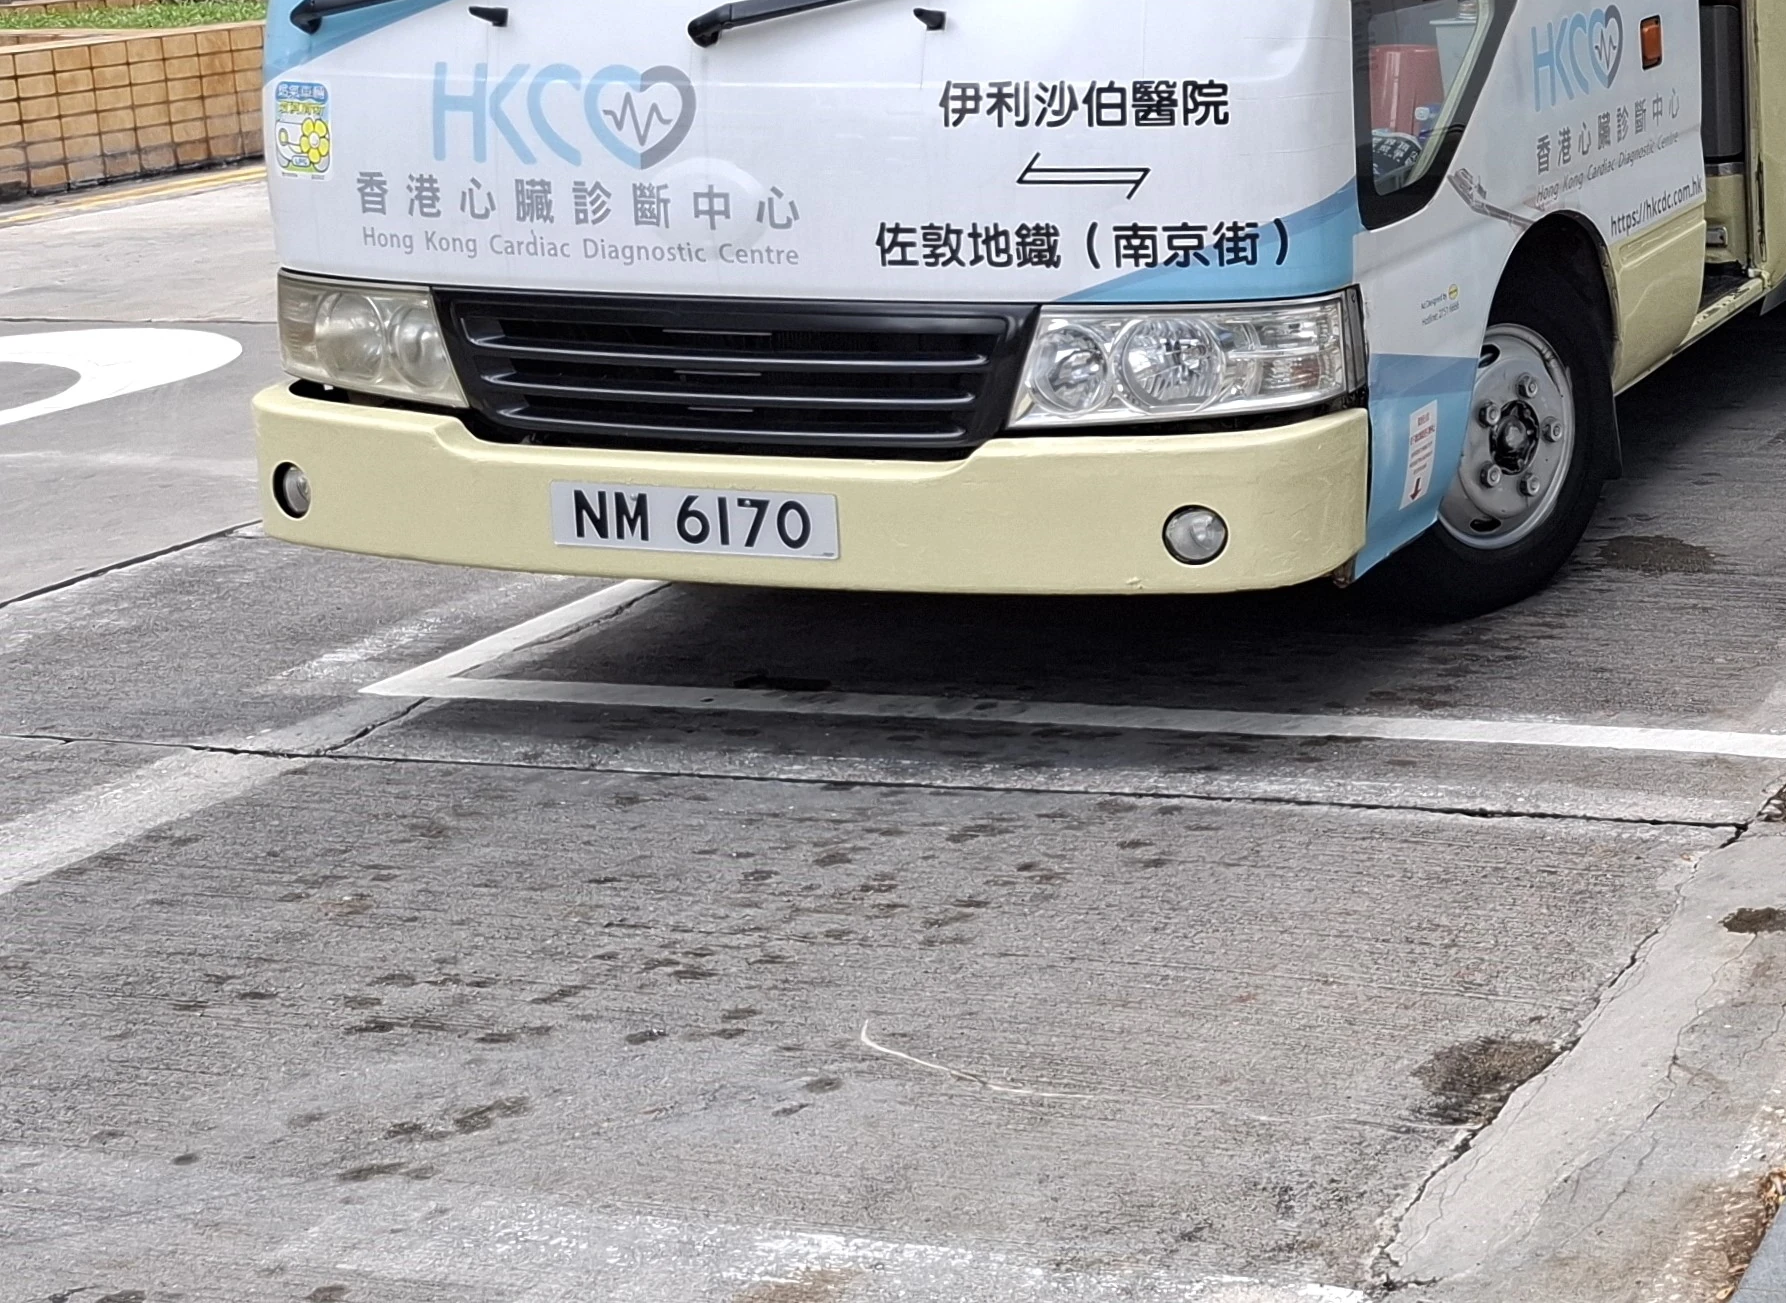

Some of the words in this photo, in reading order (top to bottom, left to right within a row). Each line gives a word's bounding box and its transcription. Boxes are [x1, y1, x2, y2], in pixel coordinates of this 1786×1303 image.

[938, 79, 1230, 129] 伊利沙伯醫院
[1536, 87, 1681, 176] 香港心臟診斷中心
[356, 171, 801, 231] 香港心臟診斷中心
[1536, 182, 1560, 203] Hong
[1562, 171, 1584, 192] Kong
[1587, 159, 1616, 181] Cardiac
[1610, 174, 1703, 237] https://hkcdc.com.hk
[362, 225, 415, 256] Hong
[425, 230, 478, 260] Kong
[489, 230, 571, 260] Cardiac
[583, 236, 705, 267] Diagnostic
[718, 243, 800, 266] Centre
[573, 489, 650, 542] NM
[676, 495, 812, 549] 6170
